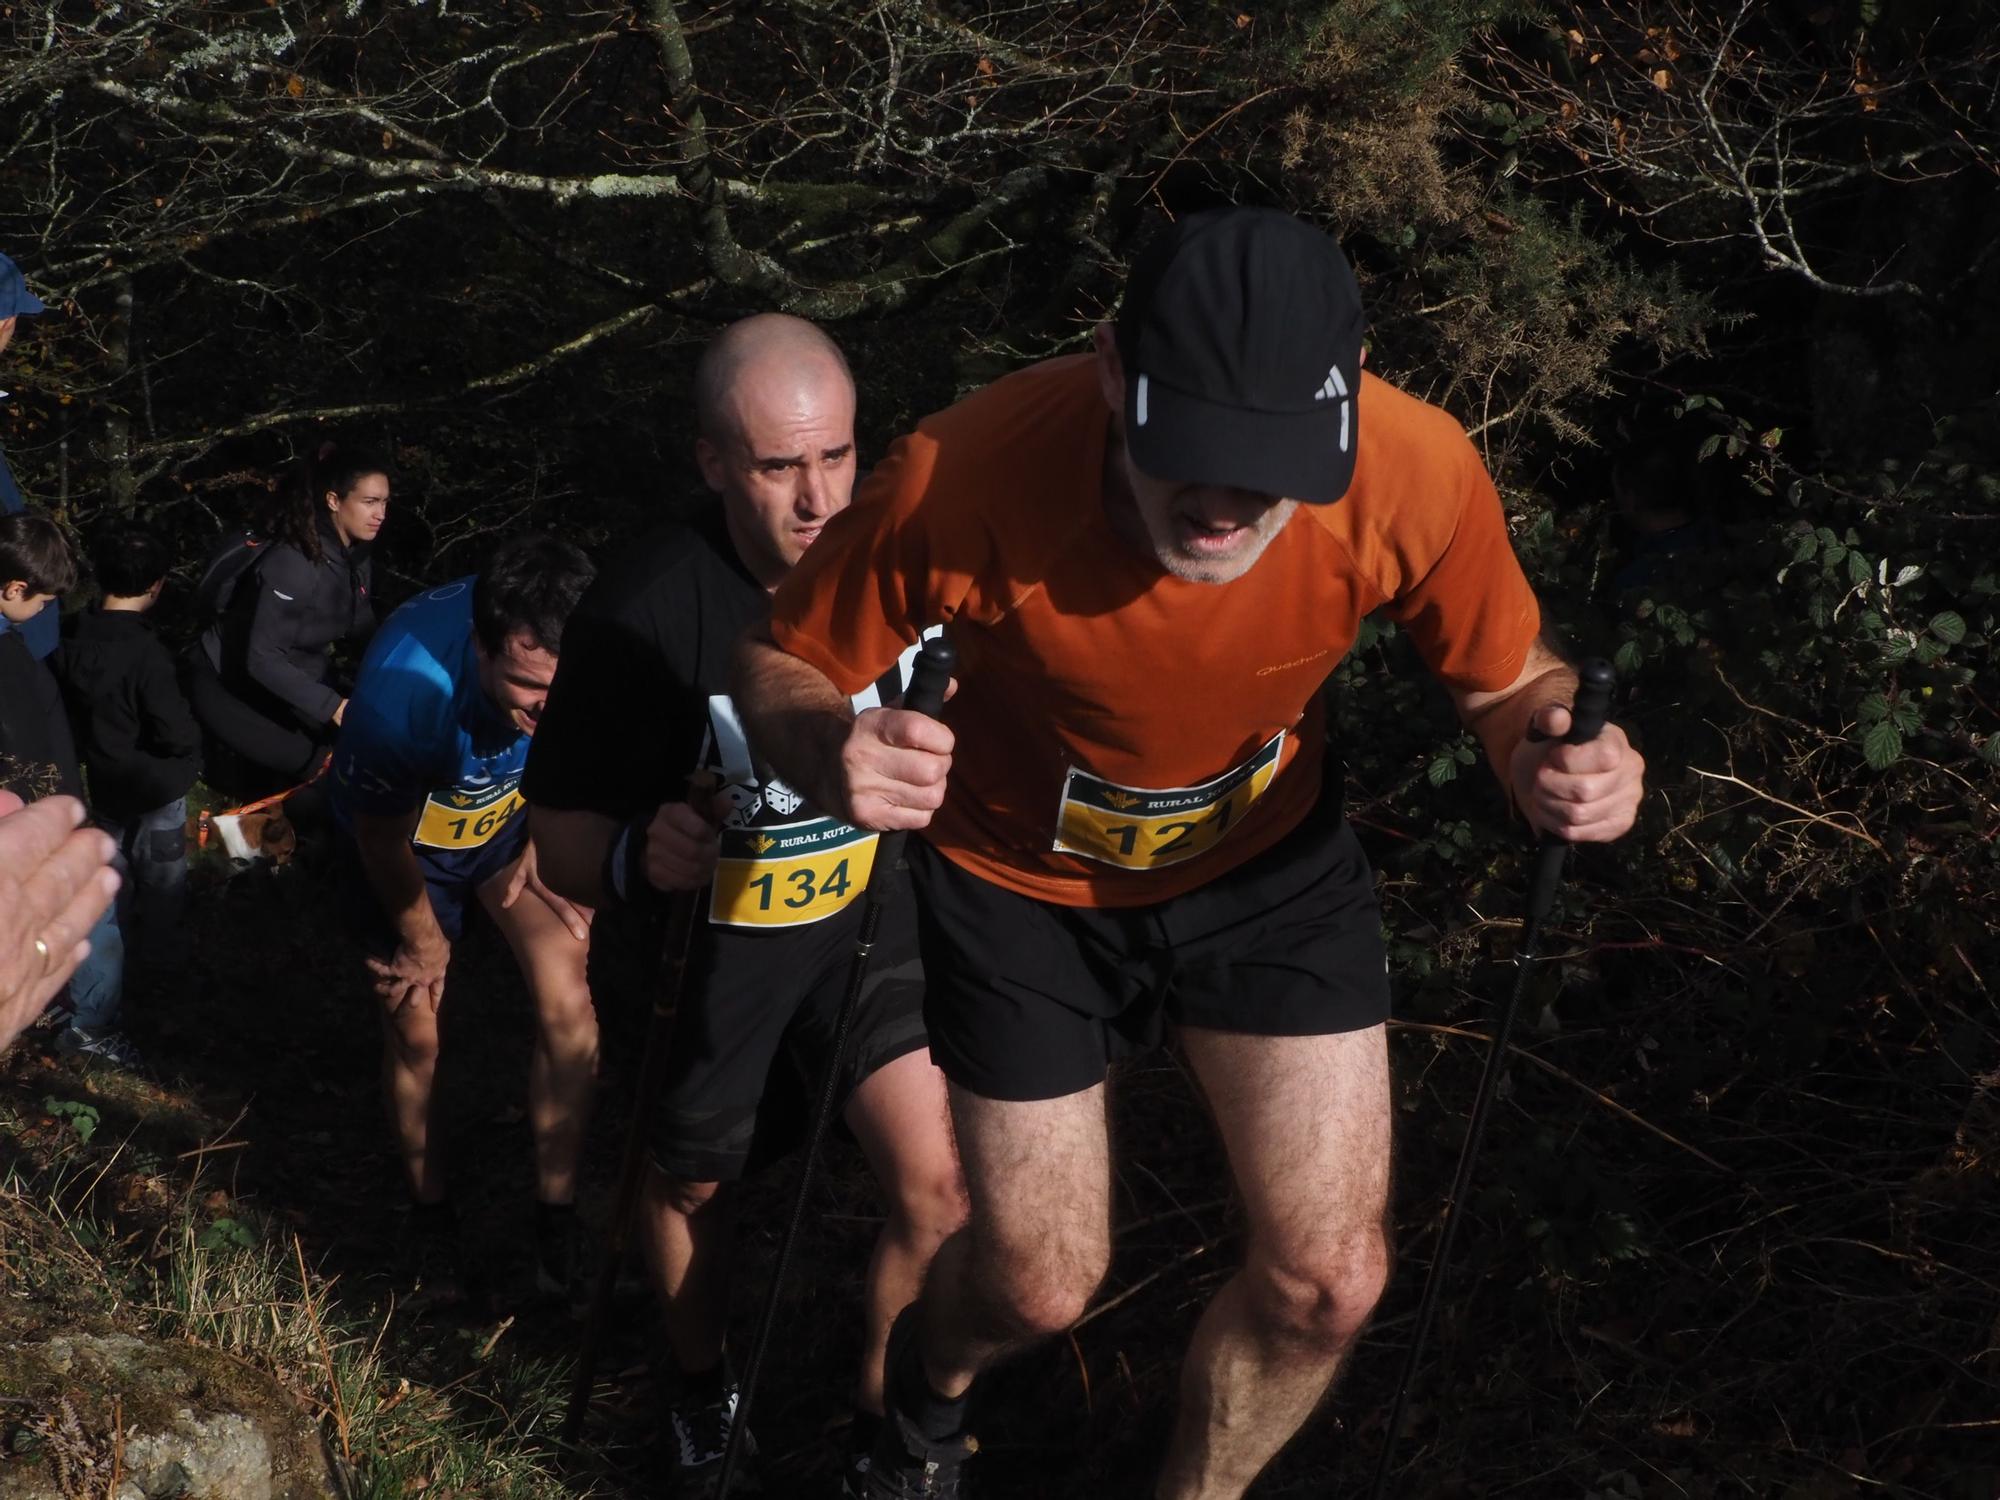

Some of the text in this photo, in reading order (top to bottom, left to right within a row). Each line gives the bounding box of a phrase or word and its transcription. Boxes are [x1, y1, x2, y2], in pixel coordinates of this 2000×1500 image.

[448, 796, 518, 840] 164
[1147, 796, 1203, 809] RURAL
[779, 823, 857, 849] RURAL KUTX
[1106, 798, 1233, 856] 121
[749, 858, 852, 911] 134
